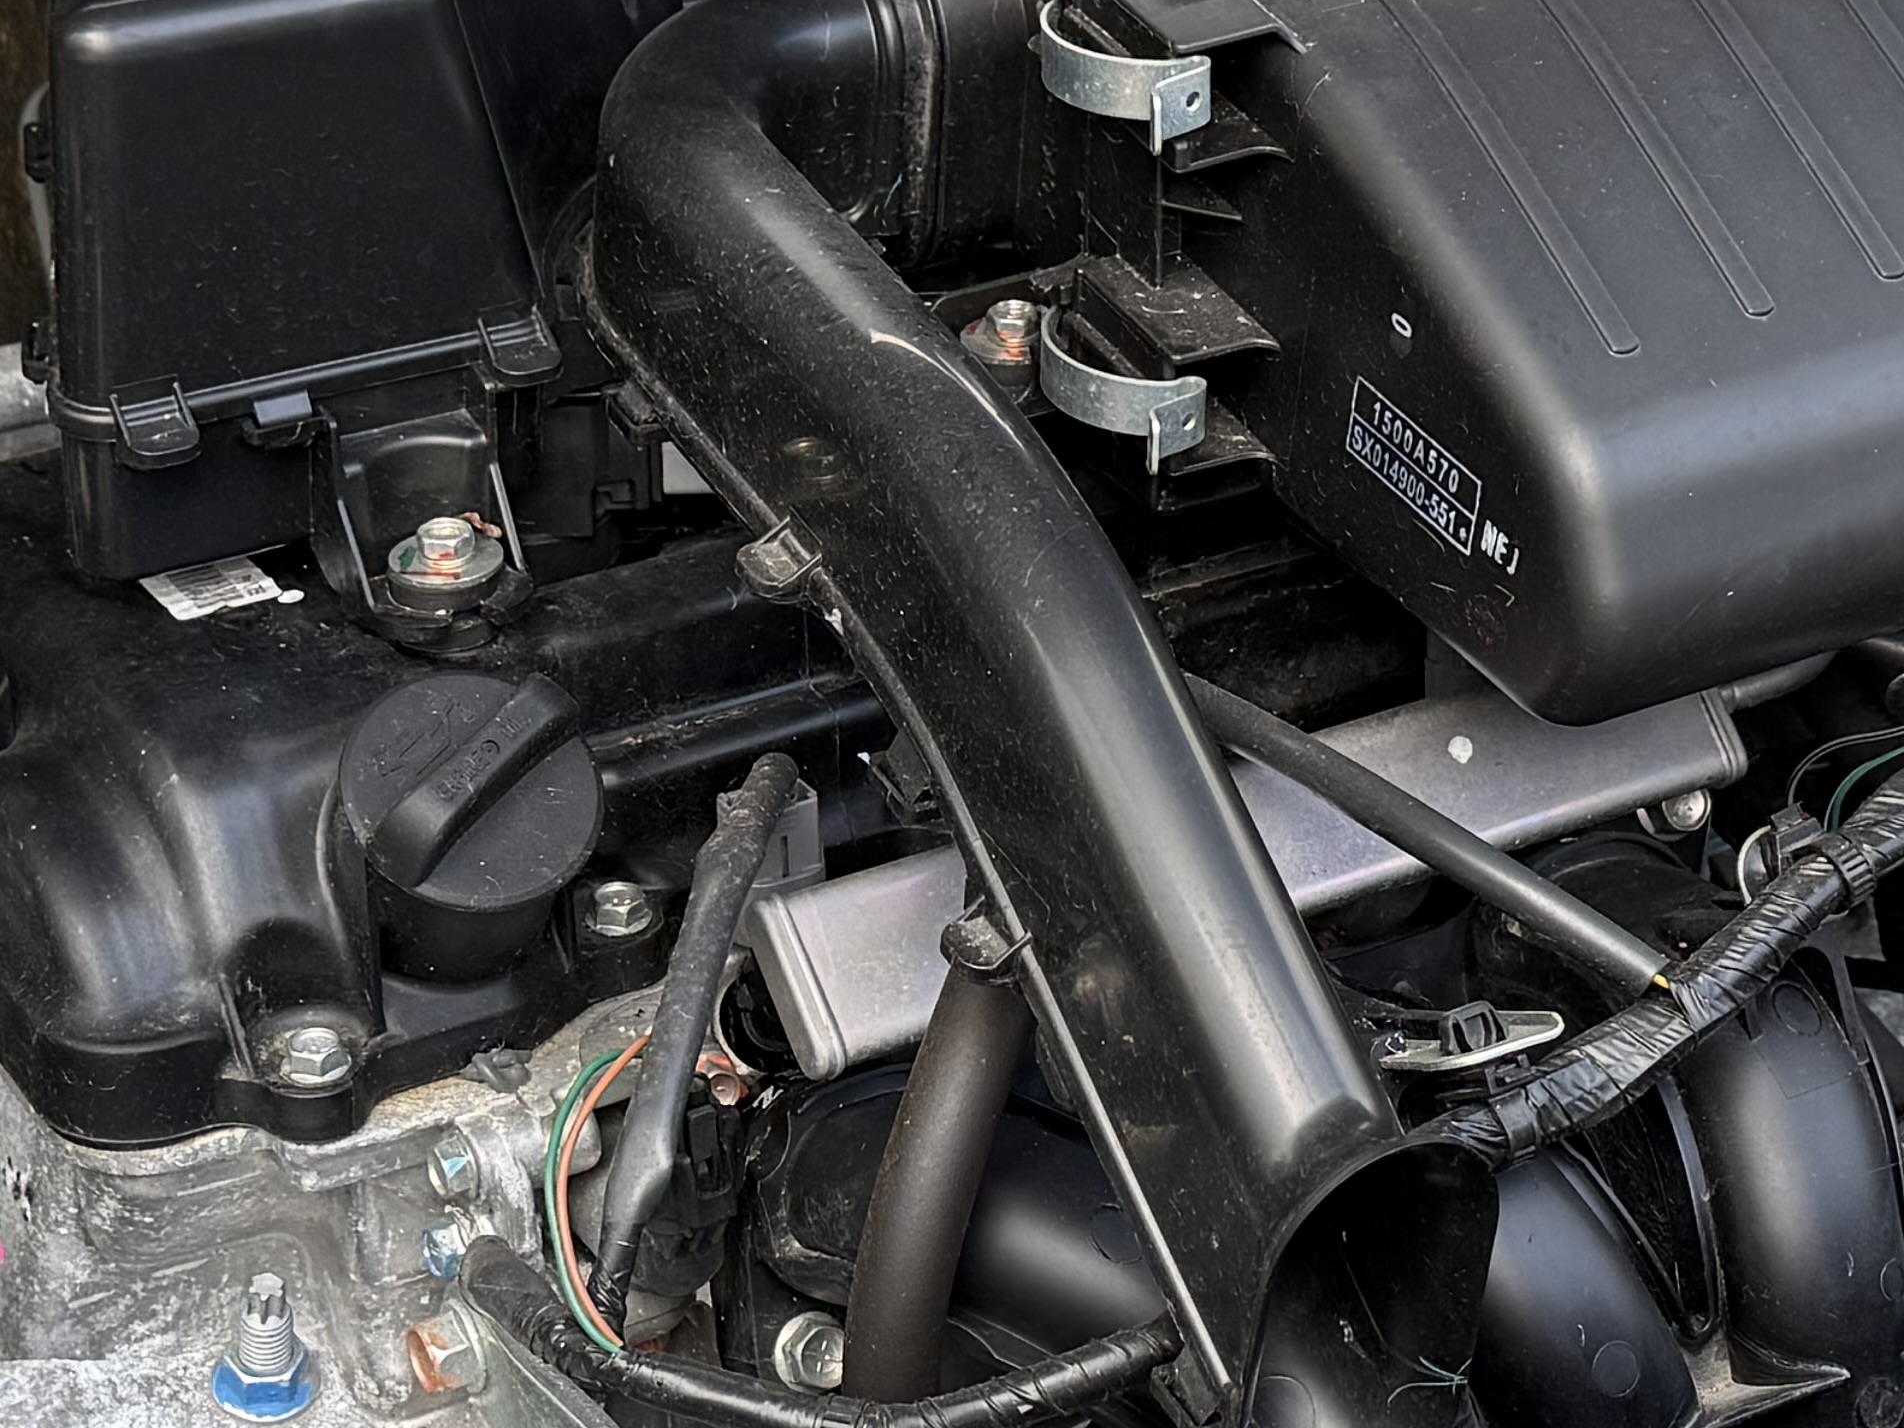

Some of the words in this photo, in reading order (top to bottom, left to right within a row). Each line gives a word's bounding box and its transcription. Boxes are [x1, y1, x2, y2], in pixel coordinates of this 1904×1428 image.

[1351, 423, 1457, 535] SX014900-551
[1372, 400, 1460, 494] 1500A570
[1480, 519, 1520, 576] NEJ
